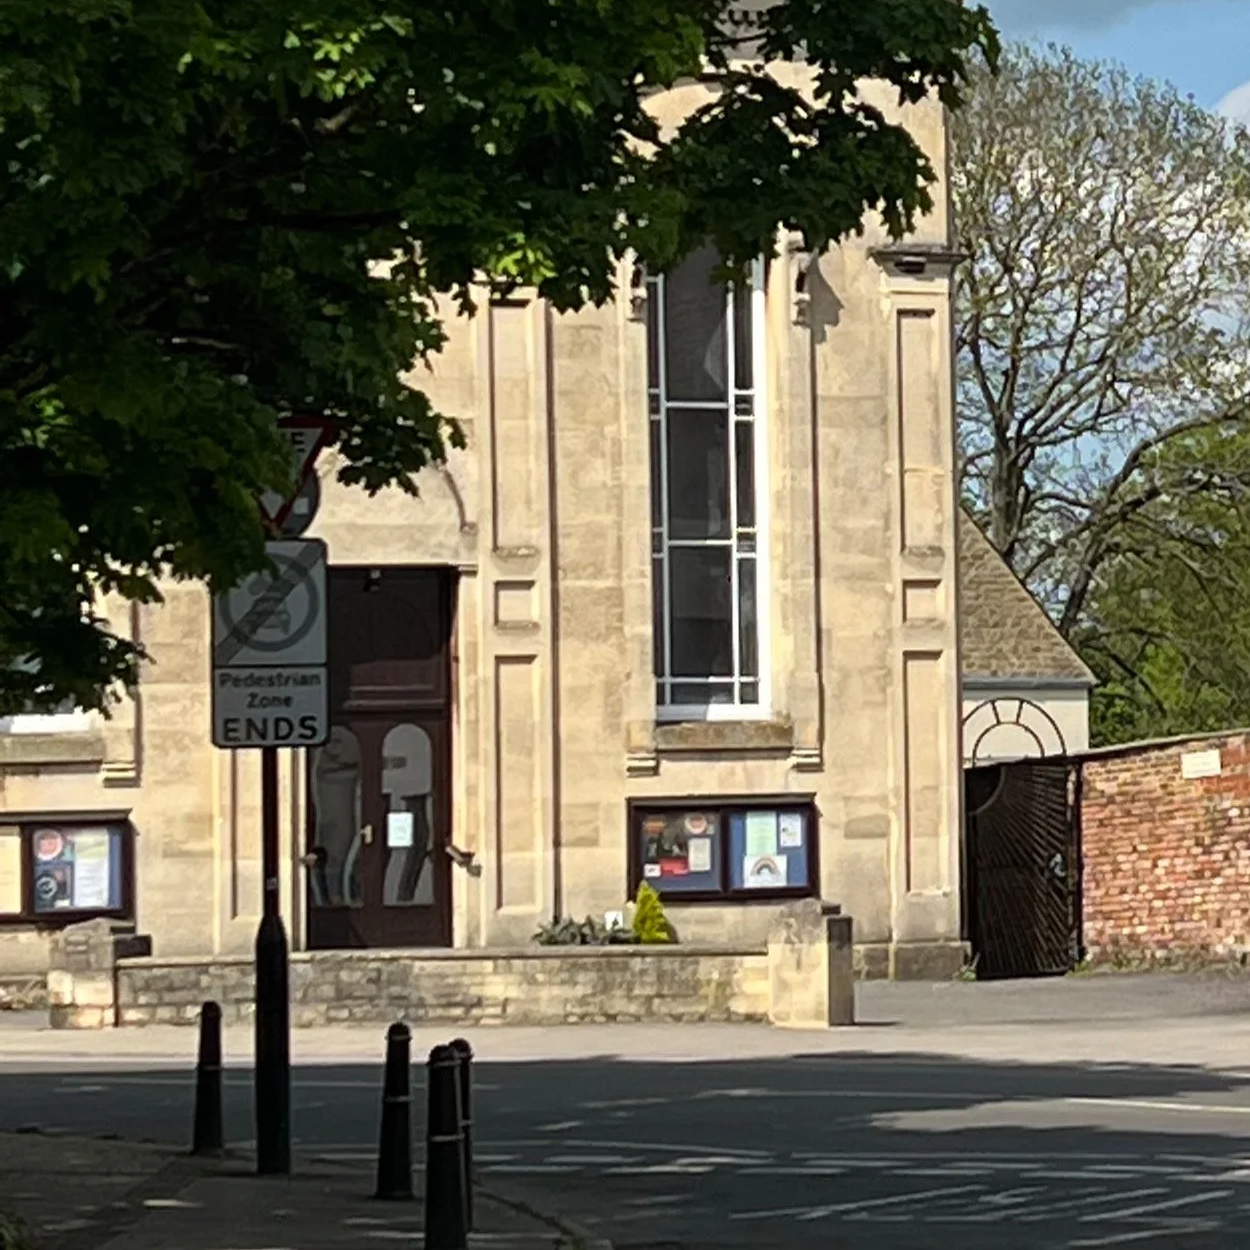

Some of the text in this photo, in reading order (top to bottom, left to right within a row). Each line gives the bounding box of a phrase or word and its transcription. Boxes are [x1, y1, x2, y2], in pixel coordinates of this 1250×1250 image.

[219, 672, 321, 688] Pedestrian
[247, 692, 293, 709] Zone
[224, 715, 318, 742] ENDS
